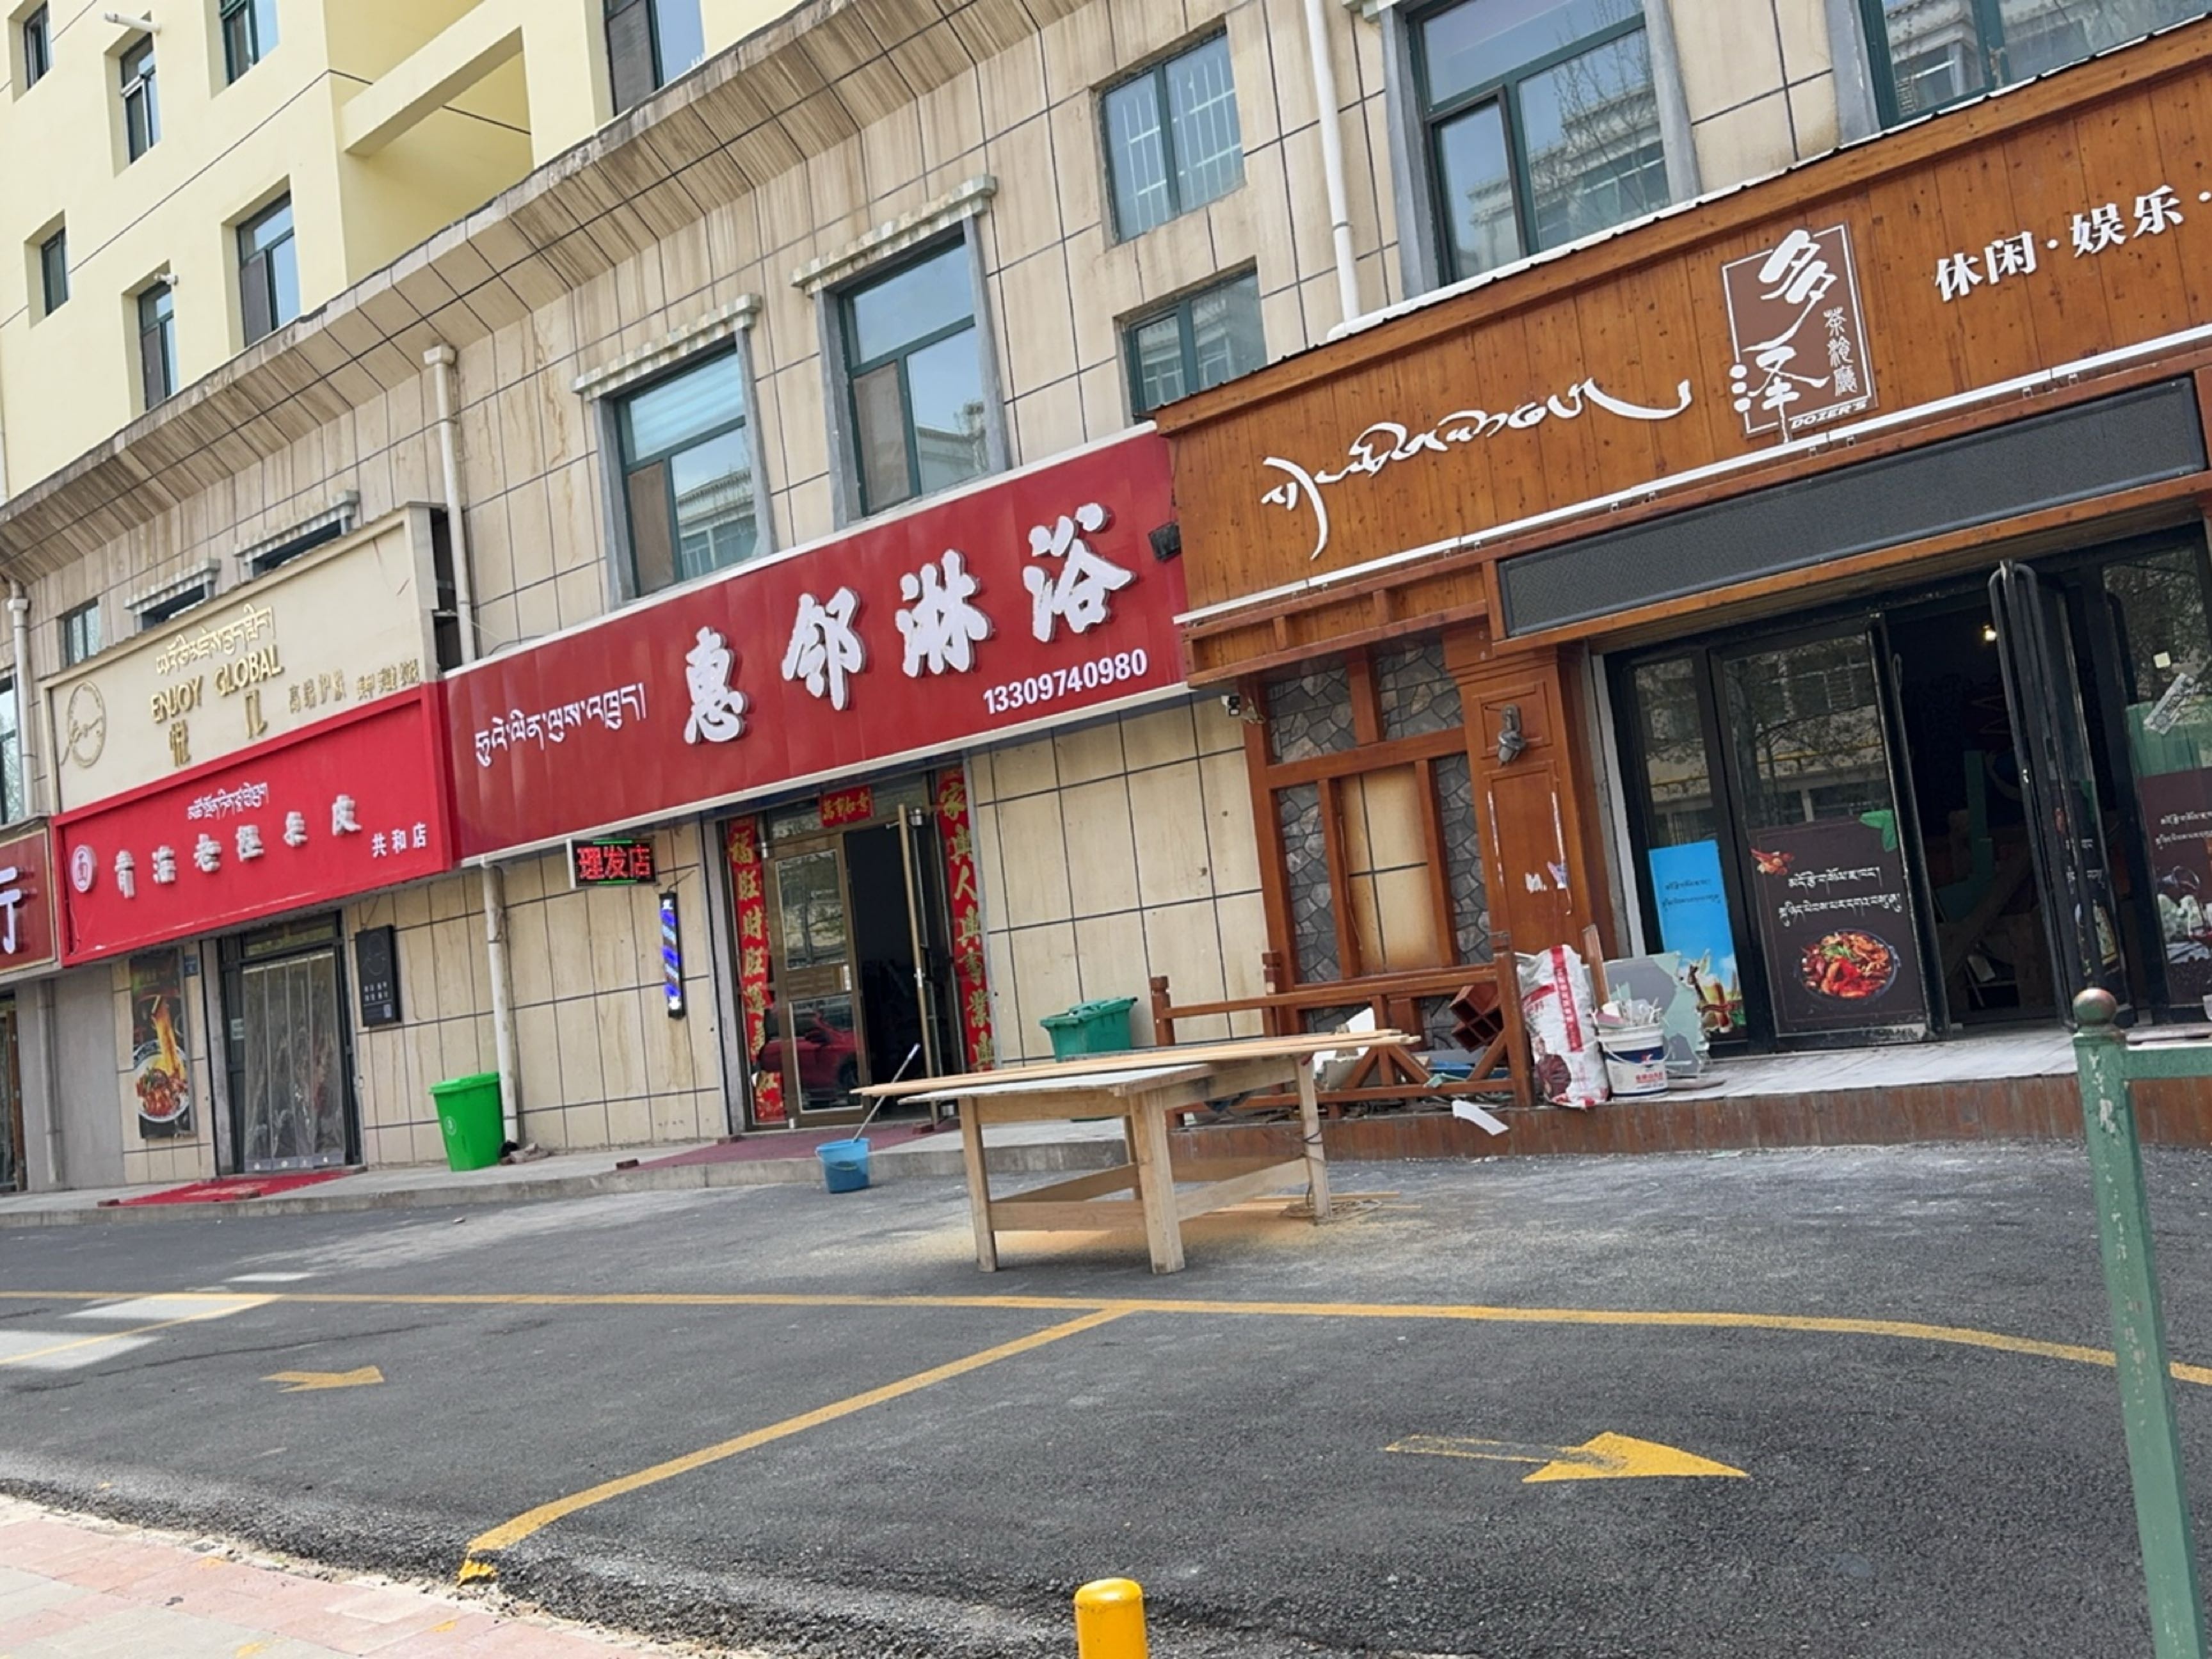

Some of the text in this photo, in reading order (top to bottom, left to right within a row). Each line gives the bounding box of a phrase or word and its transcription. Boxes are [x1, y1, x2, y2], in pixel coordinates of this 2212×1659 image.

[684, 502, 1137, 744] 惠邻淋浴
[151, 644, 285, 723] ENJOY GLOBAL
[982, 648, 1148, 714] 13309740980
[372, 822, 426, 858] 共和店
[577, 844, 651, 880] 理发店
